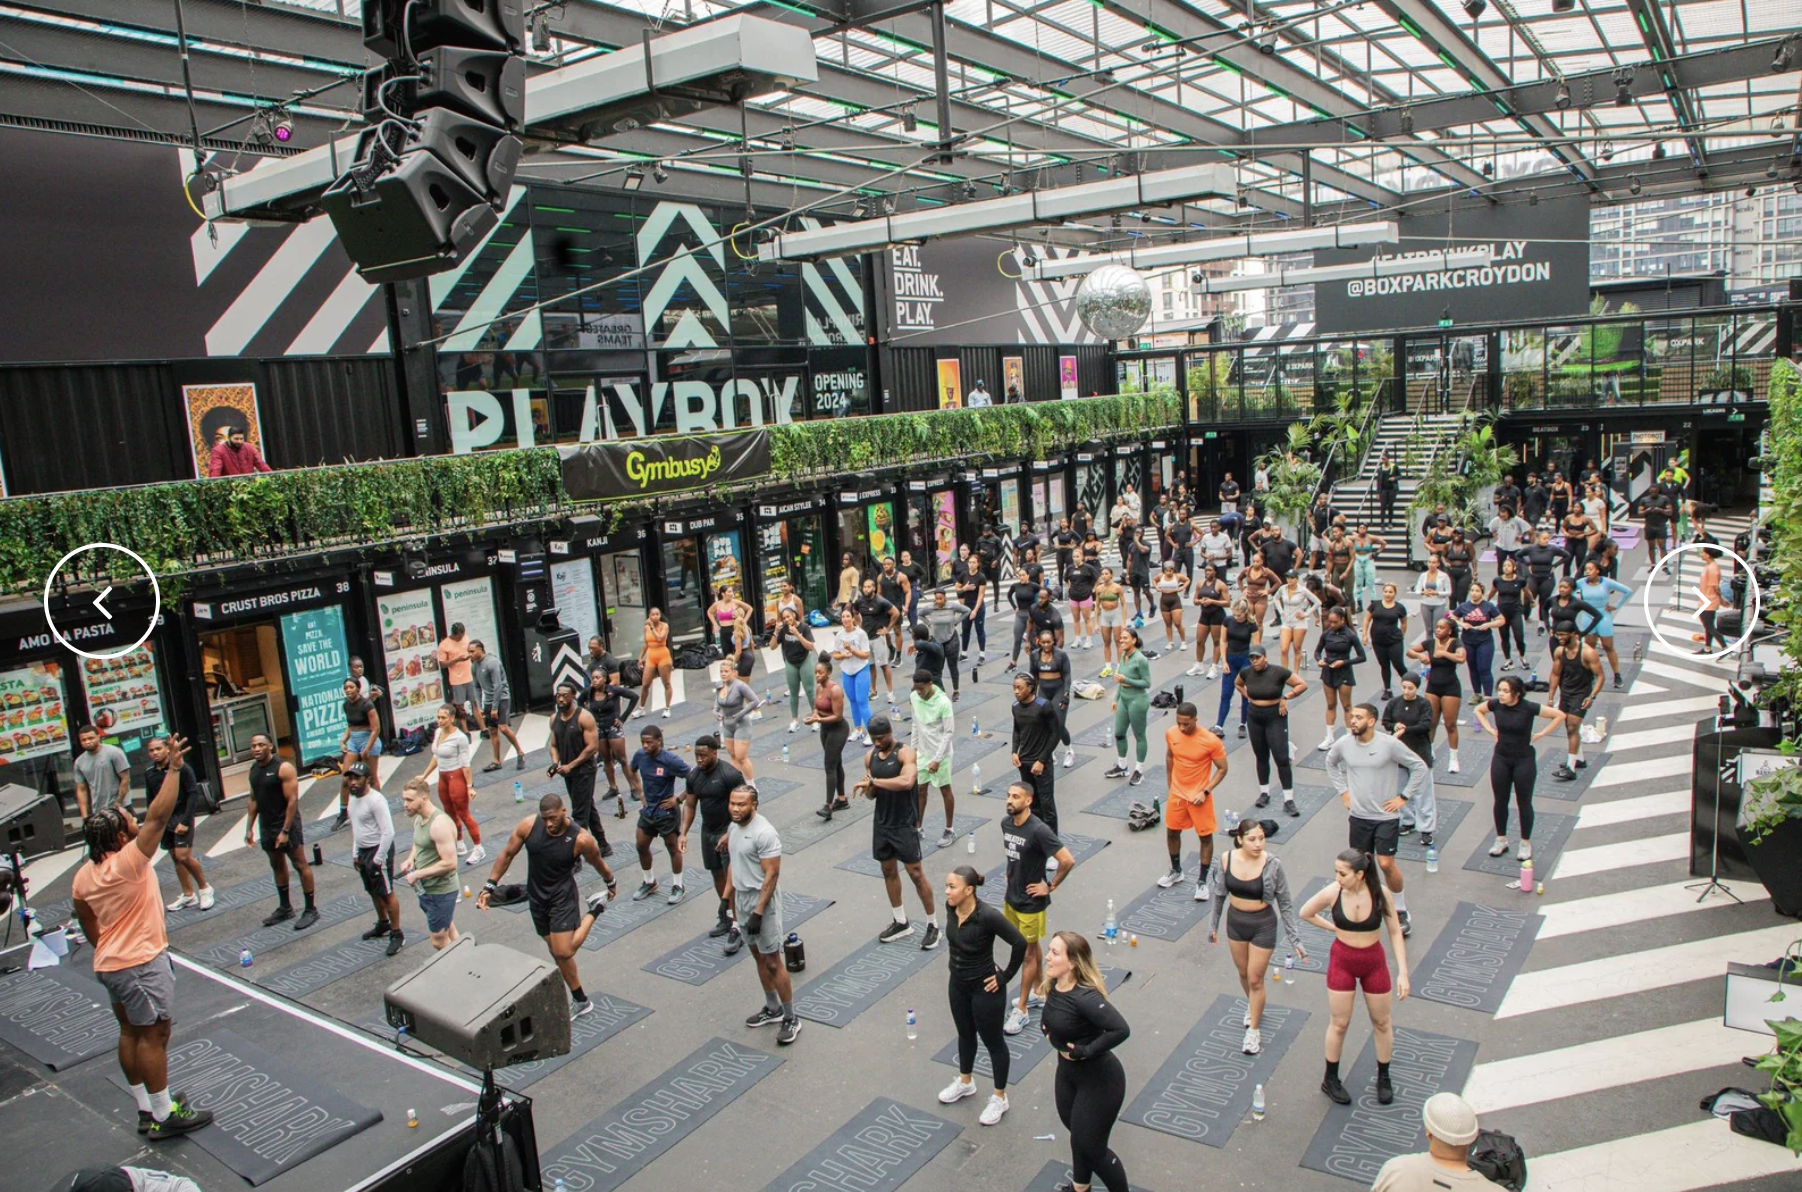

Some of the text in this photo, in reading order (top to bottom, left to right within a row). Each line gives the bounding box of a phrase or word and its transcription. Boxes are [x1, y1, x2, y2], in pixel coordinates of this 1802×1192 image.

[891, 245, 922, 268] EAT.
[894, 272, 944, 297] DRINK.
[1347, 261, 1551, 297] @BOXPARKCROYDON
[896, 303, 934, 325] PLAY.
[814, 372, 865, 392] OPENING
[816, 391, 848, 410] 2024
[1683, 421, 1692, 429] 22
[927, 477, 945, 488] EXPRESS
[862, 489, 882, 499] EXPRESS
[689, 517, 715, 530] DUB PAN
[735, 512, 744, 522] 35
[586, 536, 608, 548] KANJI
[637, 529, 646, 539] 36
[487, 556, 498, 566] 37
[335, 581, 350, 593] 38
[453, 585, 489, 600] peninsula
[221, 586, 321, 615] CRUST BROS PIZZA
[391, 599, 428, 615] peninsula
[18, 633, 51, 651] AMO
[73, 622, 115, 641] PASTA
[305, 629, 324, 641] PIZZA
[297, 637, 333, 655] SAVE THE
[294, 649, 342, 677] WORLD
[302, 700, 347, 731] PIZZA
[1003, 832, 1027, 846] GREATEST
[1420, 903, 1529, 1008] GYMSHARK
[166, 1038, 356, 1165] GYMSHARK
[539, 1042, 770, 1192] GYMSHARK
